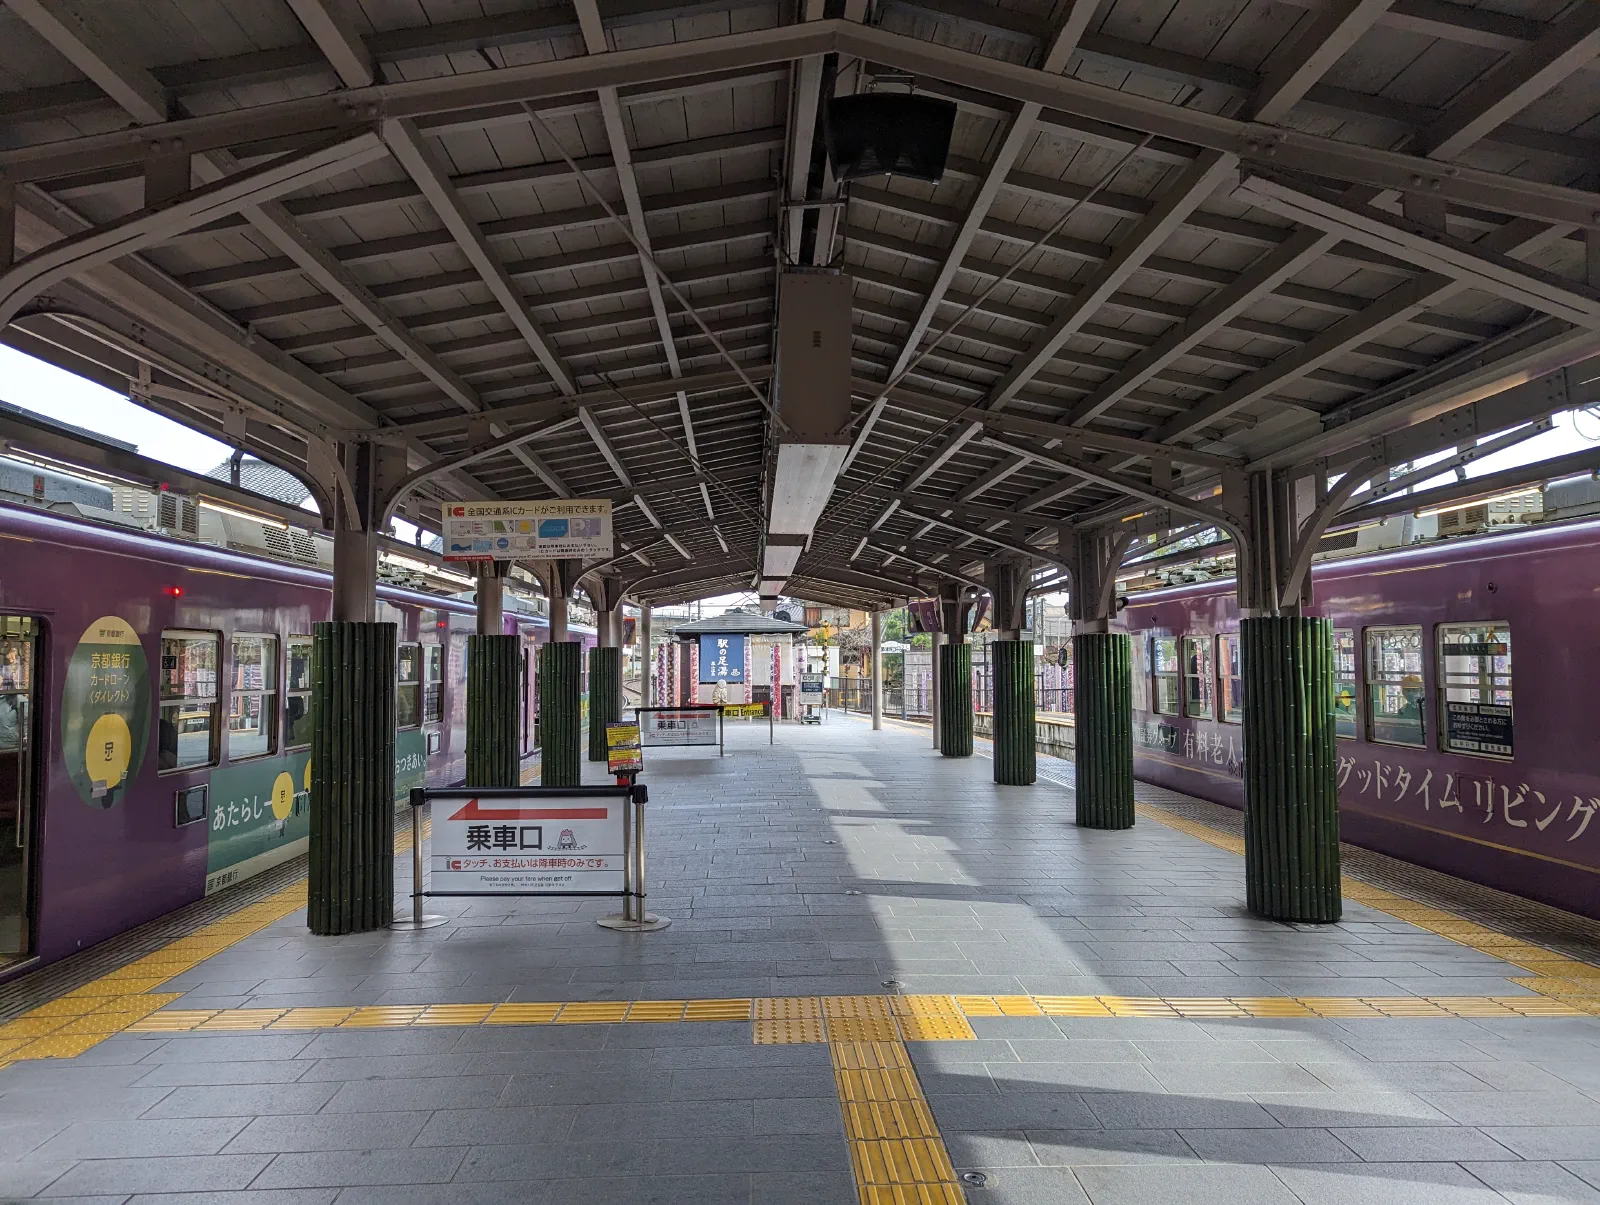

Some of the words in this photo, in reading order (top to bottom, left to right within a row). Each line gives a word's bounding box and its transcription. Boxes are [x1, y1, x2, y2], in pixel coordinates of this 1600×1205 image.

[91, 652, 130, 668] 京都銀行
[717, 638, 729, 677] 駅の足湯
[91, 674, 129, 686] カードローン
[657, 720, 686, 730] 乗車口
[1183, 728, 1239, 768] 有料老人
[466, 825, 543, 850] 乗車口
[463, 858, 609, 869] タッチ、お支払いは降車時のみです。
